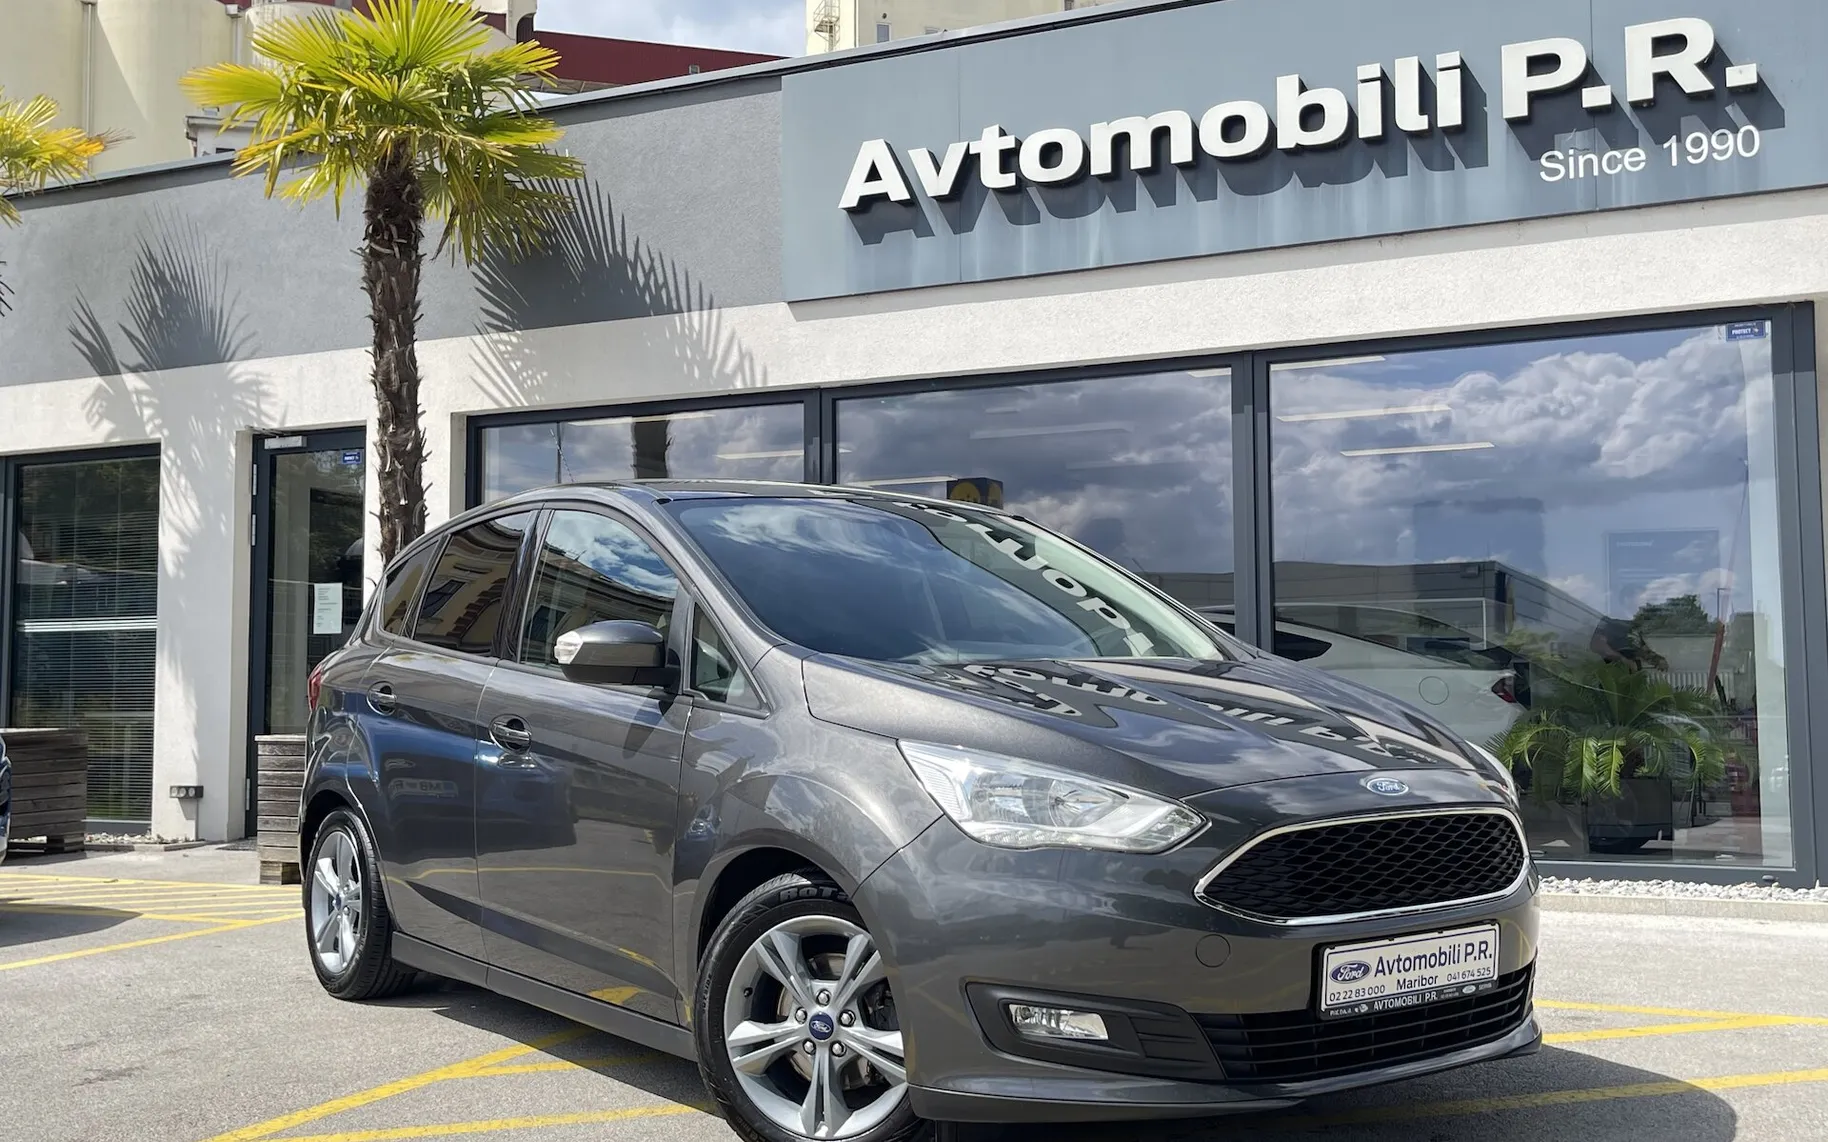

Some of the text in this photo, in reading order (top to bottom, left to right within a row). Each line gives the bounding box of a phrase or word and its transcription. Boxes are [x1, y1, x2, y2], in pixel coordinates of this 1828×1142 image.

[838, 17, 1758, 209] Avtomobili P.R.
[1539, 124, 1761, 183] Since 1990
[1376, 781, 1400, 791] Ford
[1374, 940, 1492, 978] Avtomobili P.R.
[1337, 963, 1365, 981] Ford
[1446, 967, 1491, 982] 041 674 525
[1396, 975, 1439, 991] Maribor
[1329, 984, 1386, 1002] 02 22 83 000
[1373, 993, 1422, 1011] AVTOMOBILI
